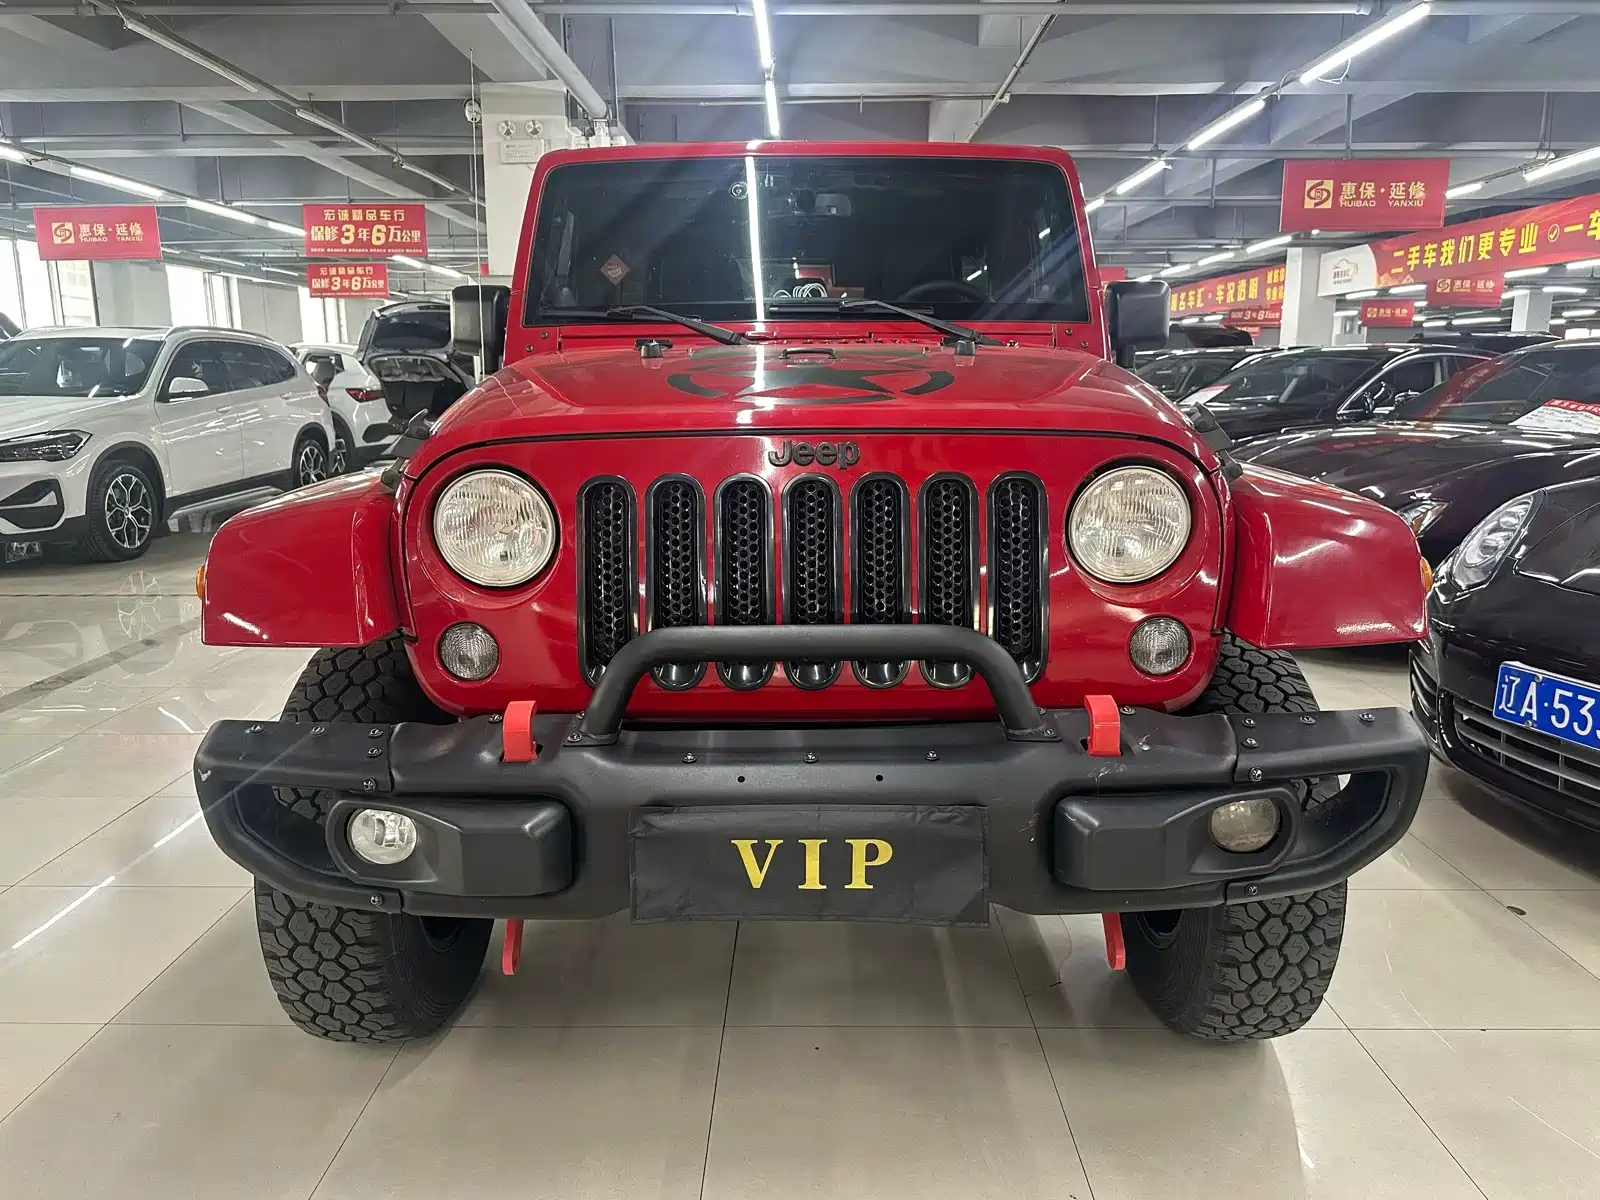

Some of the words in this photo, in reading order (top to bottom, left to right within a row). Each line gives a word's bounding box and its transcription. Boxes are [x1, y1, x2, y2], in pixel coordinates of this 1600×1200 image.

[1340, 181, 1426, 199] 惠保·延修
[1340, 199, 1376, 207] HUIBAO
[1388, 199, 1424, 207] YANXIU
[324, 209, 405, 221] 宏诚精品车行
[78, 222, 143, 237] 惠保·延修
[310, 224, 421, 246] 保修3年6万公里
[1390, 222, 1539, 274] 二手车我们更专业
[311, 276, 385, 291] 保修3年6万公里
[768, 440, 861, 469] Jeep
[1499, 674, 1600, 740] 辽A·53
[730, 839, 893, 889] VIP
